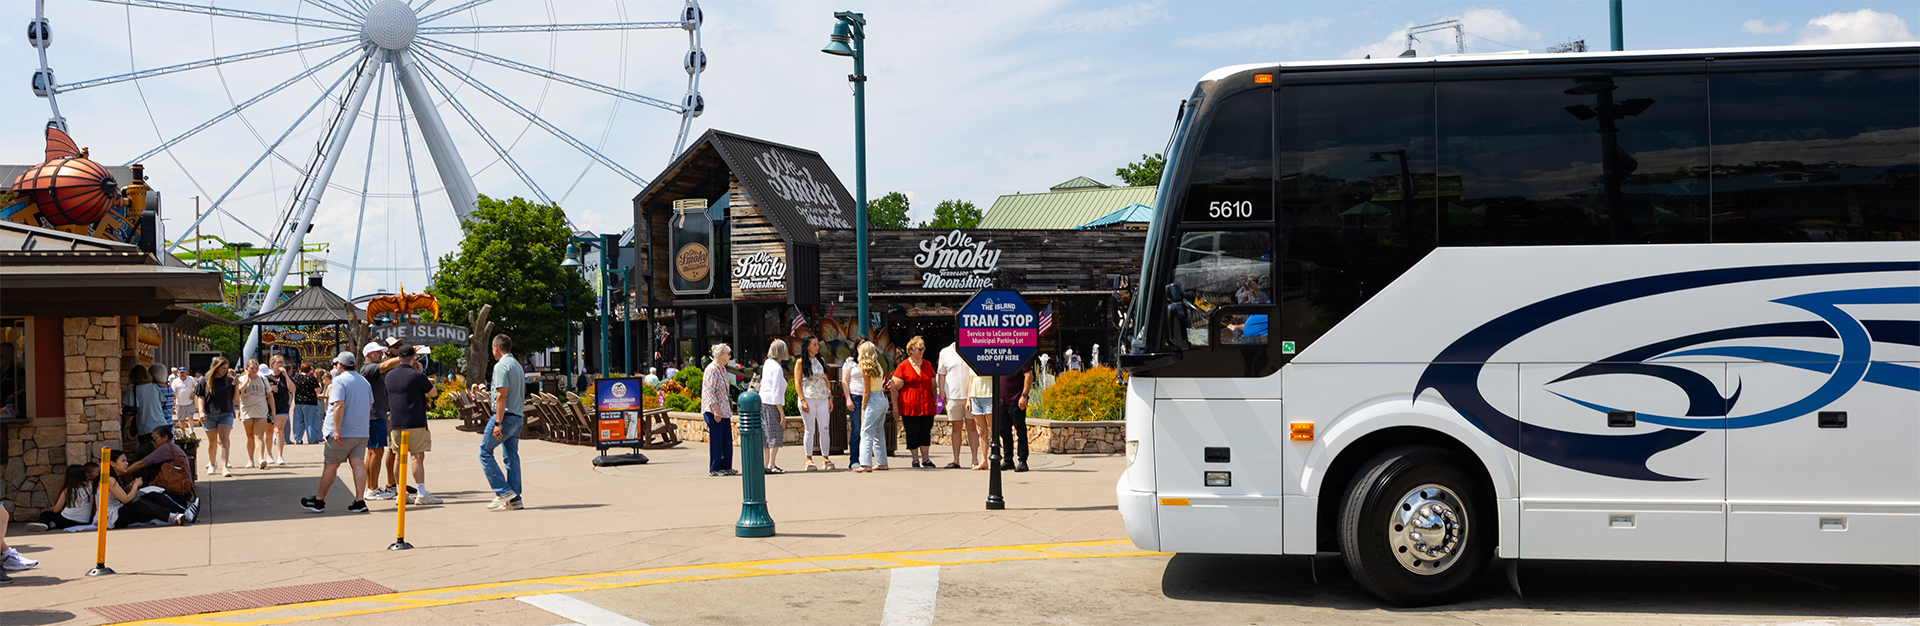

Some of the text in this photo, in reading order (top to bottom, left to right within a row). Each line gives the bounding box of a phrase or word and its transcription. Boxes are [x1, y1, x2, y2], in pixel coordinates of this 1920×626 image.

[754, 152, 842, 215] Smoky
[1209, 200, 1252, 218] 5610
[947, 229, 977, 249] Ole
[679, 251, 708, 266] Smoky
[755, 251, 773, 263] Ole
[914, 235, 1002, 275] Smoky
[733, 255, 787, 281] Smoky
[939, 268, 969, 277] Tennessee
[739, 278, 785, 289] Moonshine
[922, 272, 994, 289] Moonshine
[981, 303, 1016, 311] THE ISLAND
[962, 314, 1034, 327] TRAM STOP
[376, 325, 407, 340] THE
[413, 325, 467, 342] ISLAND
[972, 337, 996, 345] Municipal
[997, 337, 1015, 345] Parking
